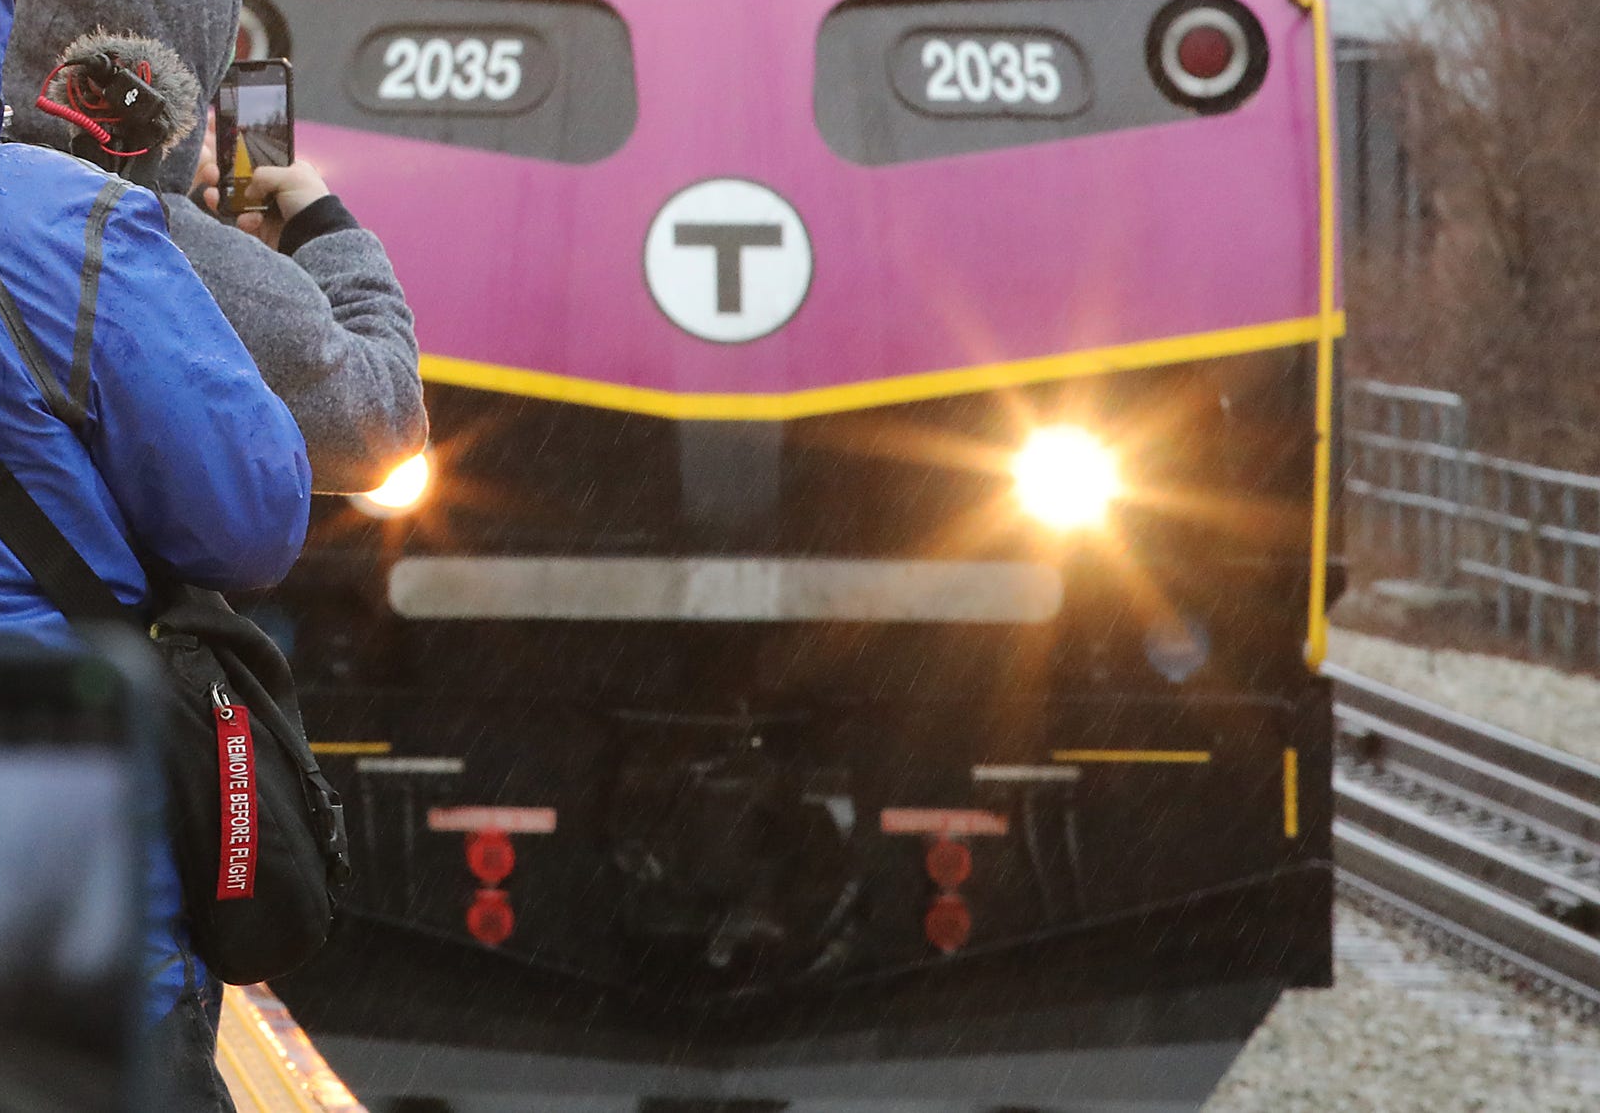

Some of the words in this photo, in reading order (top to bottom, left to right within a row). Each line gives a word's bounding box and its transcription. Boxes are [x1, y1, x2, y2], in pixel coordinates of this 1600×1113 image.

[378, 37, 524, 101] 2035
[920, 38, 1062, 104] 2035
[673, 223, 783, 315] T
[226, 735, 248, 789] REMOVE
[229, 793, 250, 845] BEFORE
[226, 847, 249, 890] FLIGHT
